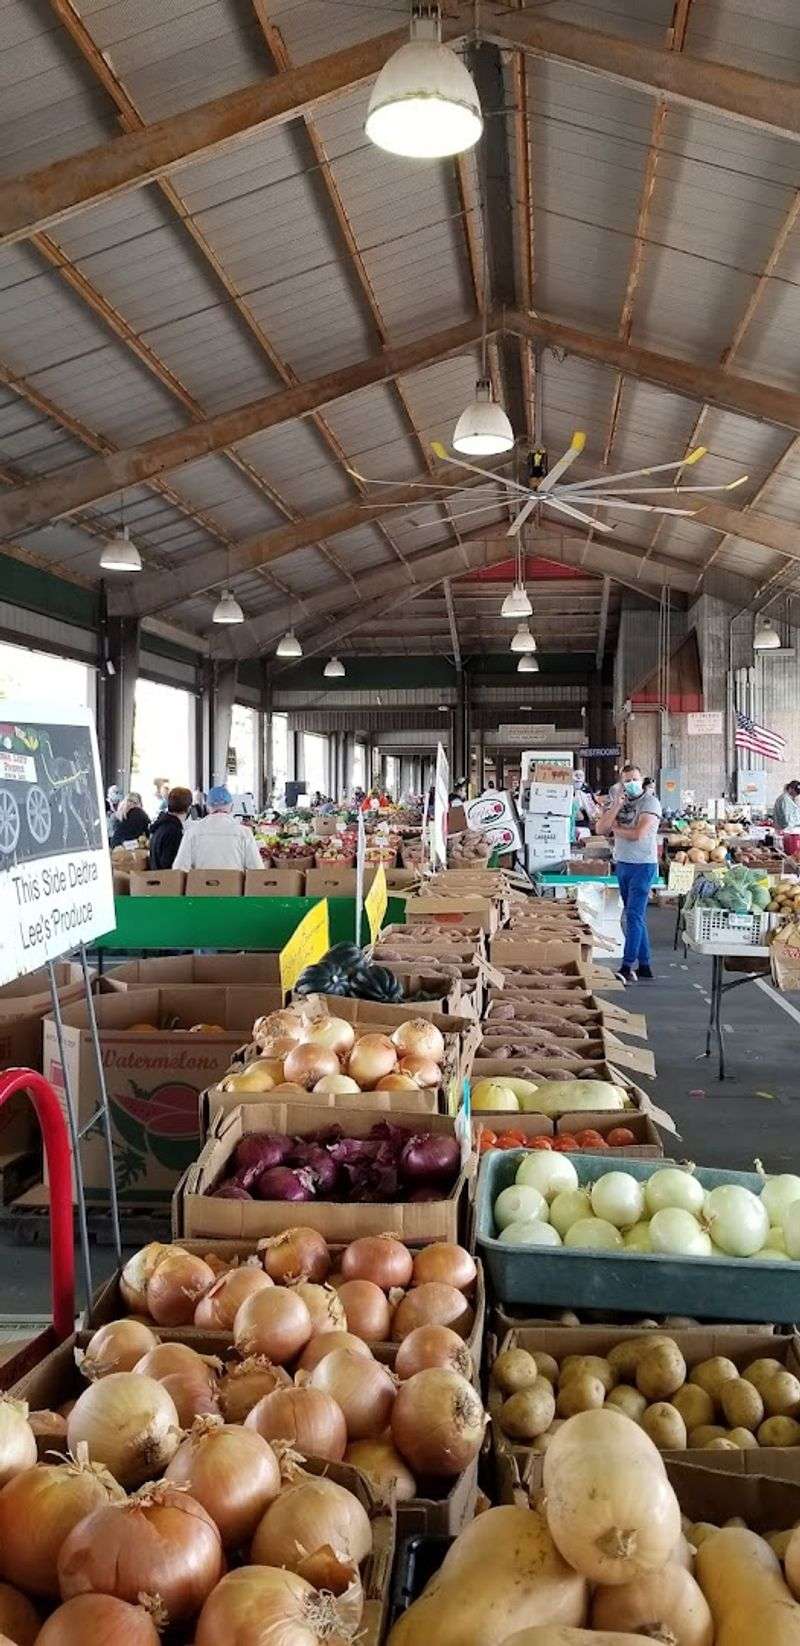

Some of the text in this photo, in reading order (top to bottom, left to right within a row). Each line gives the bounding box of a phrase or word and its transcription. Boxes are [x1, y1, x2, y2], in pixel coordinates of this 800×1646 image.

[12, 876, 40, 905] This
[41, 866, 67, 896] Side
[19, 902, 93, 949] Lee's Produce
